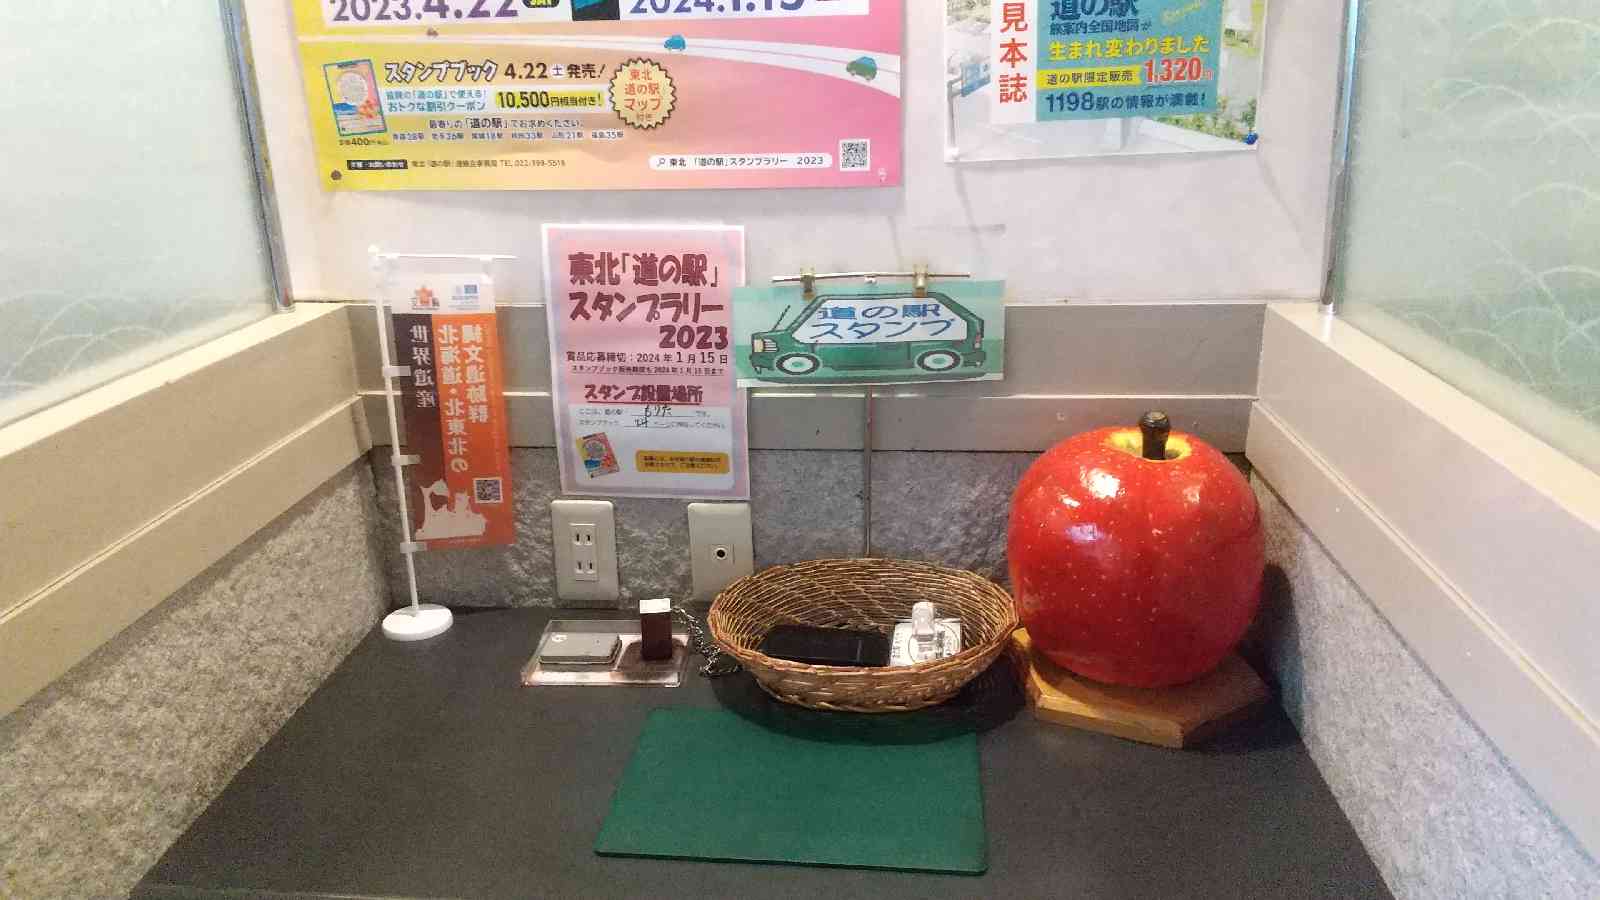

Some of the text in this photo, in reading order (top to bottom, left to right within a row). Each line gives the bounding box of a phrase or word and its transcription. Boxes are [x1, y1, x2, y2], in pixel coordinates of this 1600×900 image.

[999, 2, 1029, 104] 見本誌
[1050, 34, 1210, 59] 生まれ変わりました
[384, 58, 498, 83] スタンプブック
[630, 68, 654, 81] 東北
[1046, 70, 1133, 86] 道の駅限定販売
[624, 82, 661, 96] 道の駅
[623, 97, 661, 111] マップ
[669, 159, 687, 167] 東北
[796, 156, 824, 165] 2023
[567, 251, 719, 288] 東北「道の駅」
[568, 291, 725, 323] スタンプラリー
[816, 302, 941, 320] 道の駅
[658, 325, 729, 350] 2023
[584, 384, 704, 403] スタンプ設置場所
